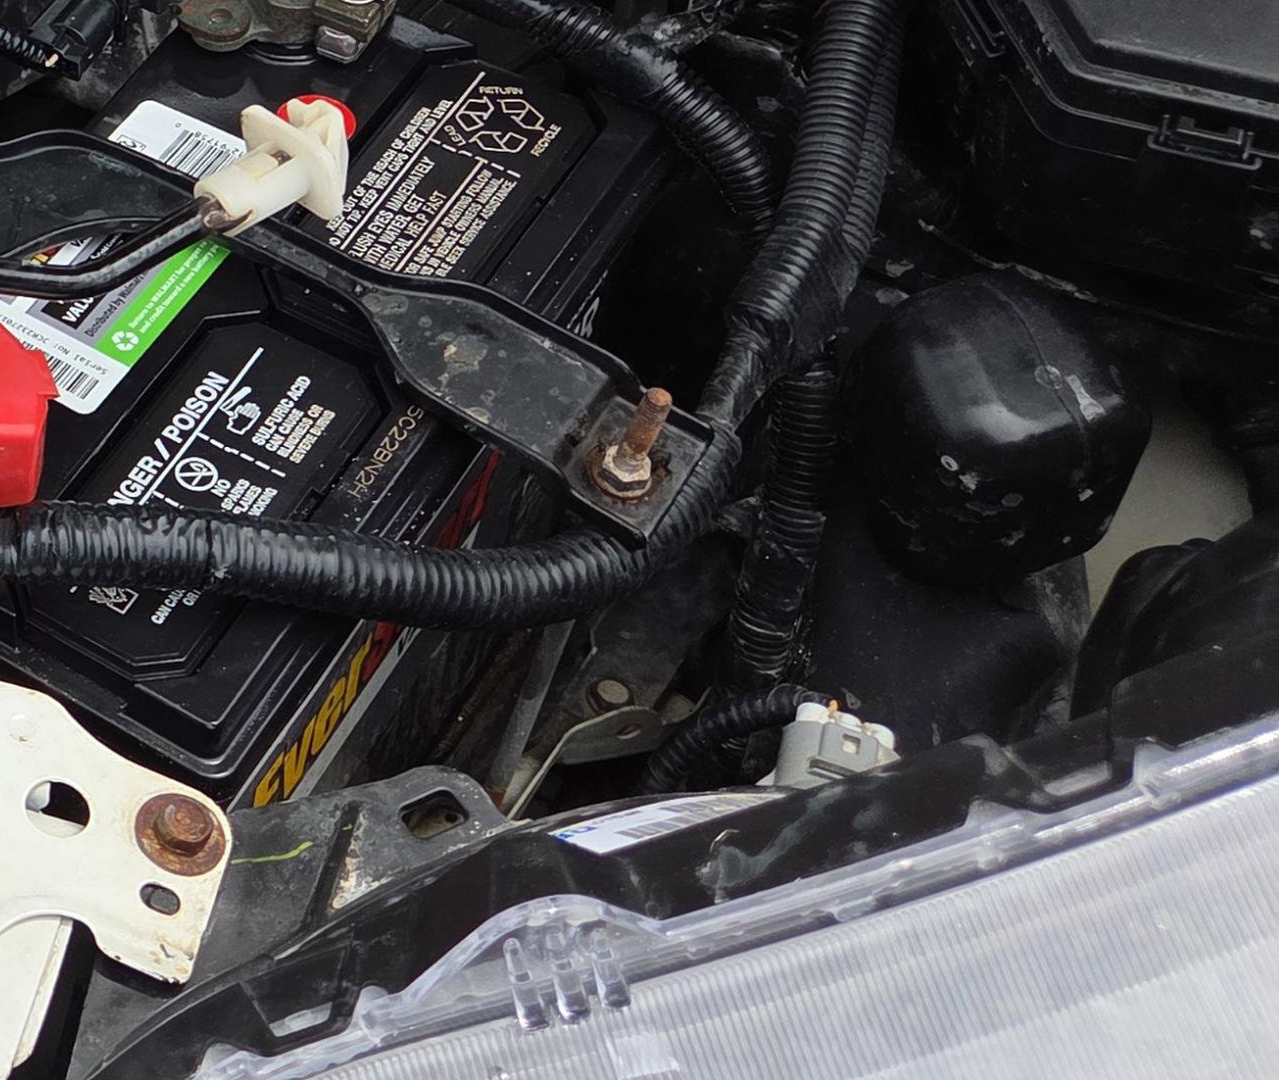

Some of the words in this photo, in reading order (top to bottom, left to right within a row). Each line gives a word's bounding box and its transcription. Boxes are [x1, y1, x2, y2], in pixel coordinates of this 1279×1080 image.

[479, 86, 523, 95] RETURN
[444, 124, 467, 147] LEAD
[530, 123, 562, 158] RECYCLE
[338, 220, 355, 239] NOT
[361, 188, 380, 214] KEEP
[378, 170, 394, 192] VENT
[390, 151, 409, 173] CAPS
[405, 132, 424, 155] TIGHT
[422, 118, 437, 134] AND
[432, 99, 454, 120] LEVEL
[343, 197, 357, 215] OUT
[354, 185, 367, 198] OF
[362, 174, 379, 188] THE
[375, 148, 397, 175] REACH
[392, 137, 404, 150] OF
[400, 106, 432, 139] CHILDREN
[374, 206, 393, 235] EYES
[386, 155, 436, 213] IMMEDIATELY
[404, 194, 426, 214] GET
[406, 214, 430, 238] HELP
[424, 190, 448, 216] FAST
[418, 240, 437, 263] SAFE
[433, 223, 450, 245] JUMP
[442, 194, 474, 228] STARTING
[470, 169, 493, 196] FOLLOW
[436, 229, 461, 260] VEHICLE
[448, 247, 466, 266] SEEK
[464, 220, 487, 246] SERVICE
[129, 310, 148, 329] Return
[151, 273, 180, 302] WALMART
[139, 319, 152, 335] and
[149, 301, 166, 321] credit
[161, 281, 183, 306] toward
[193, 250, 213, 273] battery
[85, 303, 117, 337] Distributed
[113, 297, 128, 313] by
[52, 342, 71, 356] No:
[74, 354, 107, 375] Serial
[252, 401, 294, 446] SULFURIC
[289, 375, 312, 403] ACID
[265, 430, 285, 452] CAN
[279, 409, 304, 435] CAUSE
[276, 418, 312, 458] BLINDNESS
[307, 404, 324, 420] OR
[107, 457, 164, 506] NGER
[161, 371, 230, 443] POISON
[289, 431, 318, 465] SEVERE
[312, 409, 336, 437] BURNS
[347, 404, 425, 499] 5C22BN2H
[211, 479, 232, 497] NO
[222, 478, 250, 511] SPARKS
[151, 604, 171, 625] CAN
